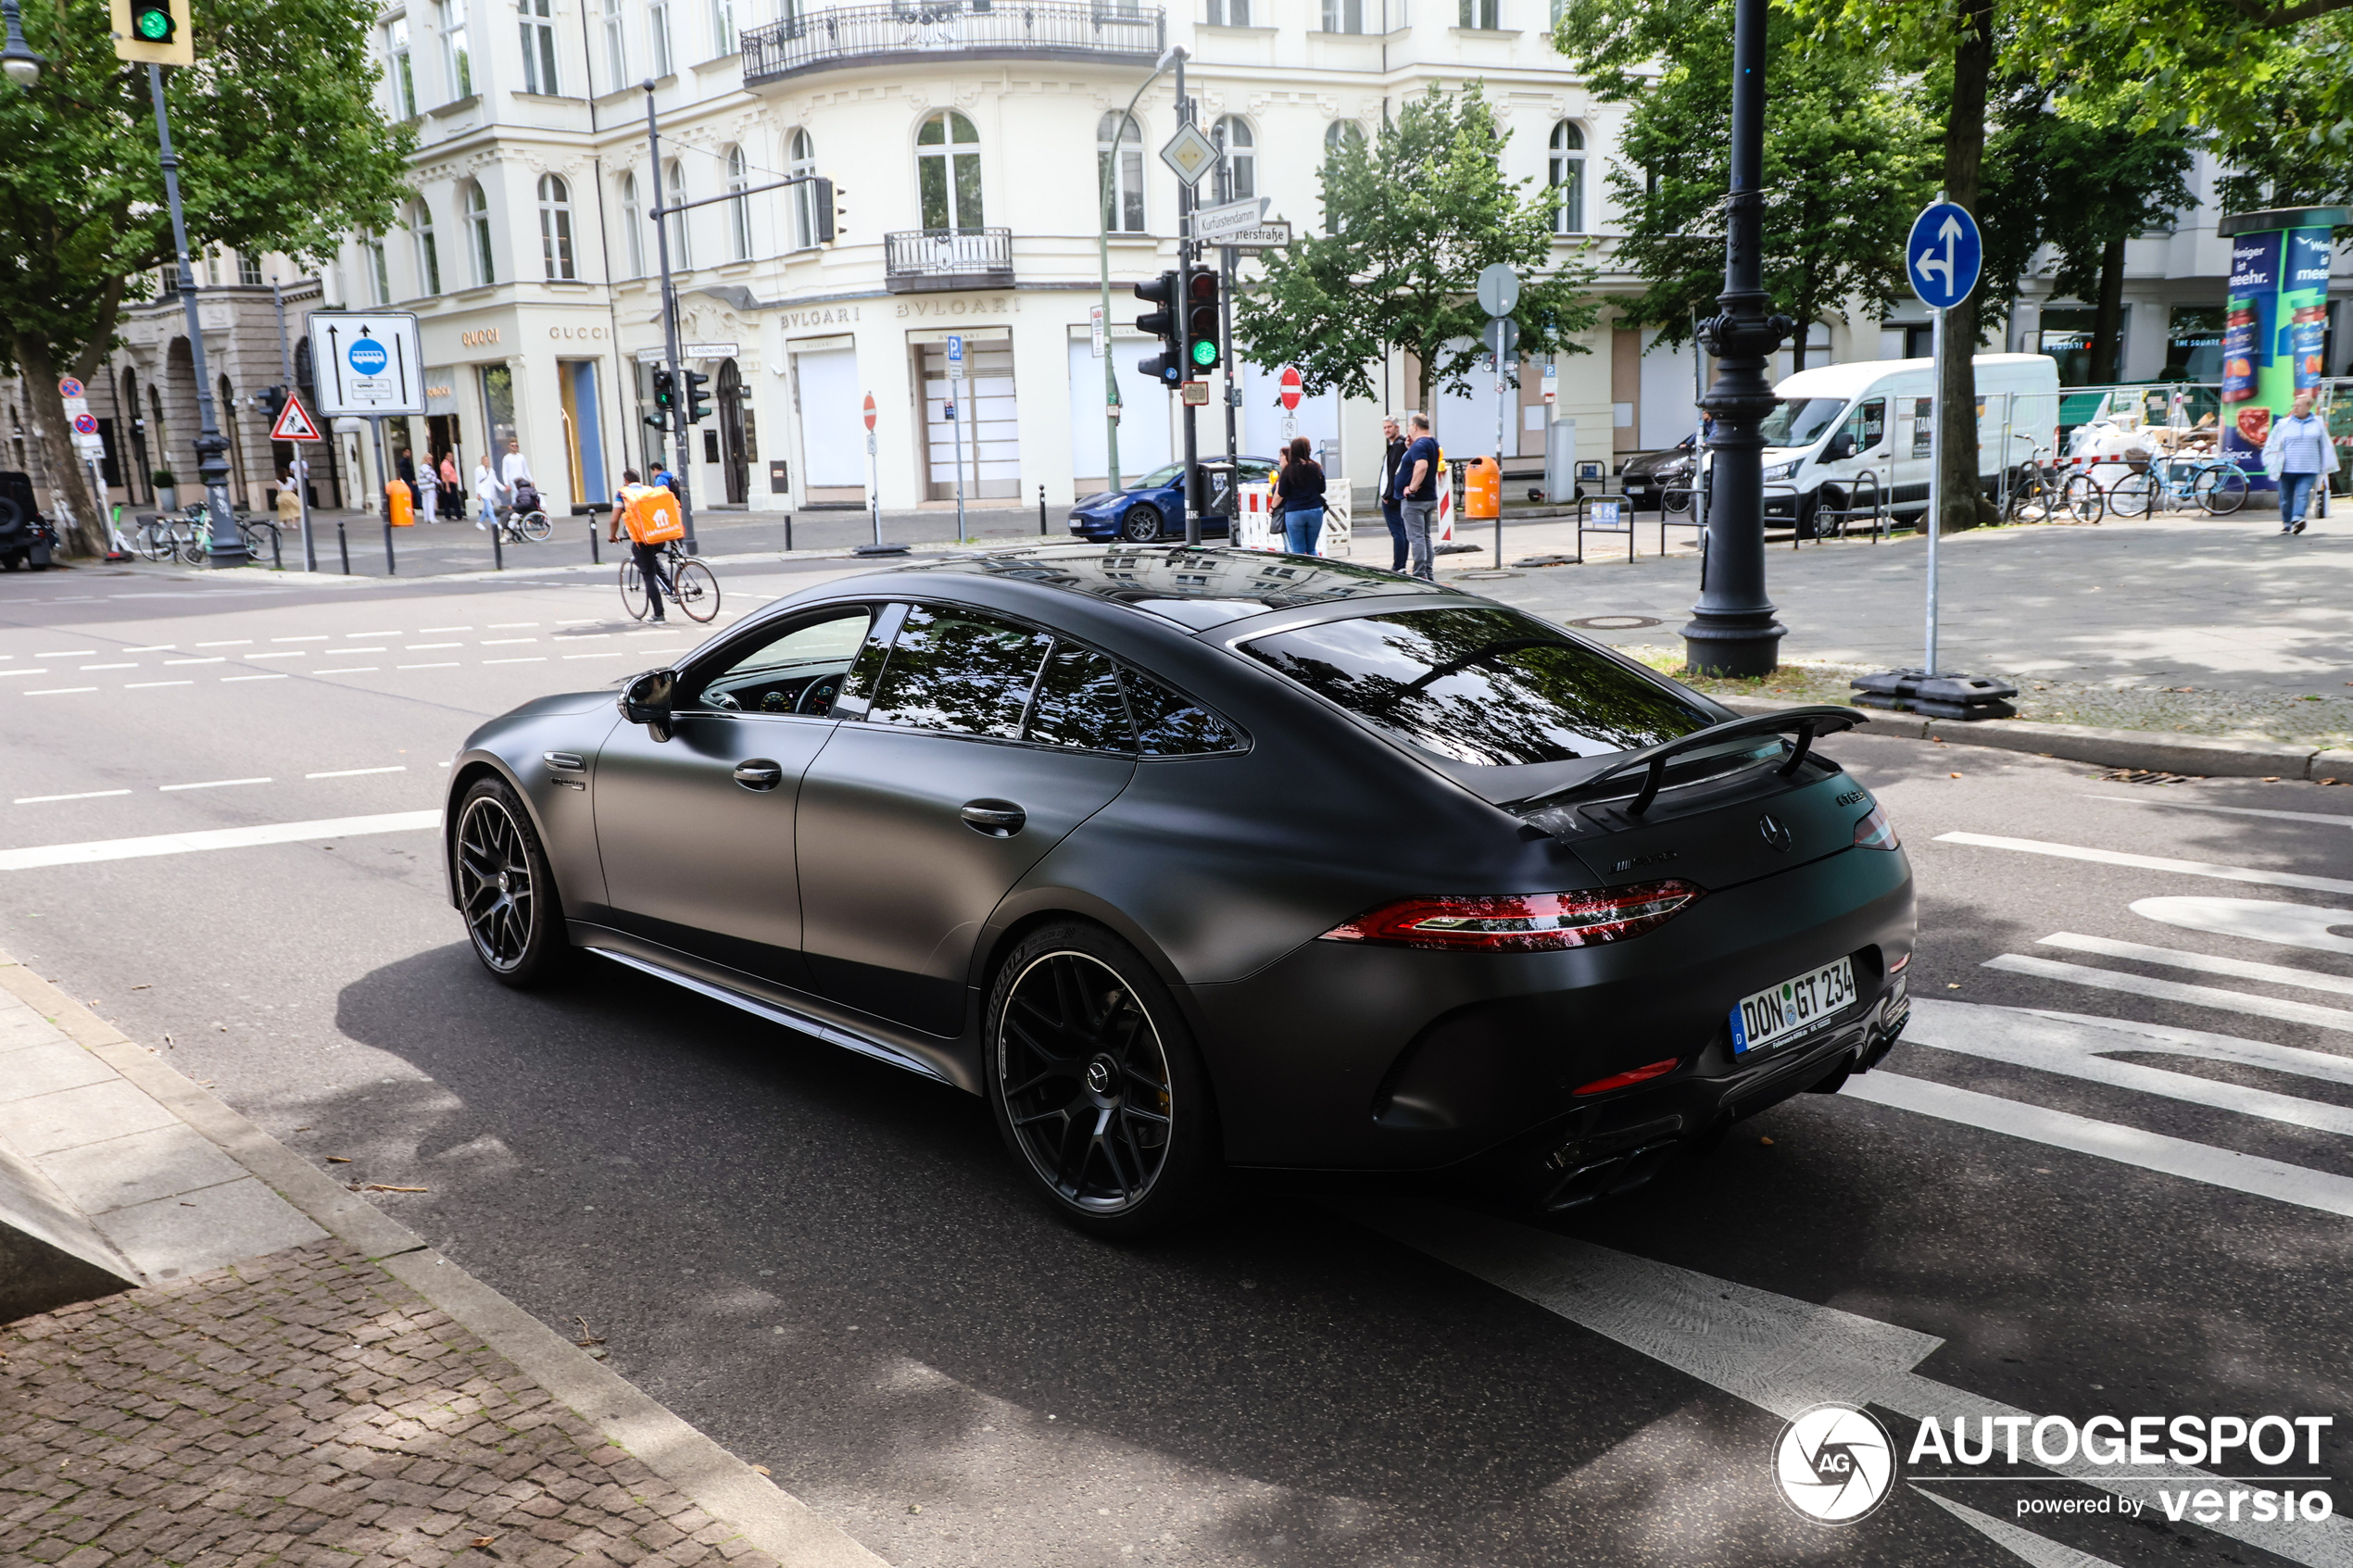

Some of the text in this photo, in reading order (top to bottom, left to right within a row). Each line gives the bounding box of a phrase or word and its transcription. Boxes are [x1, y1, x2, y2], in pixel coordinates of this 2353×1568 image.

[1202, 210, 1254, 232] Kurfürstendamm
[895, 297, 1021, 317] BVLGARI
[781, 307, 860, 328] BVLGARI
[462, 327, 499, 346] GUCCI
[549, 326, 609, 339] GUCCI
[2052, 342, 2084, 350] SQUARE
[2190, 338, 2220, 346] SQUARE
[426, 386, 450, 397] GUCCI
[1915, 417, 1931, 433] TAN
[988, 947, 1022, 1029] MICHELIN
[1743, 961, 1854, 1043] DON GT 234
[1736, 1033, 1743, 1045] D
